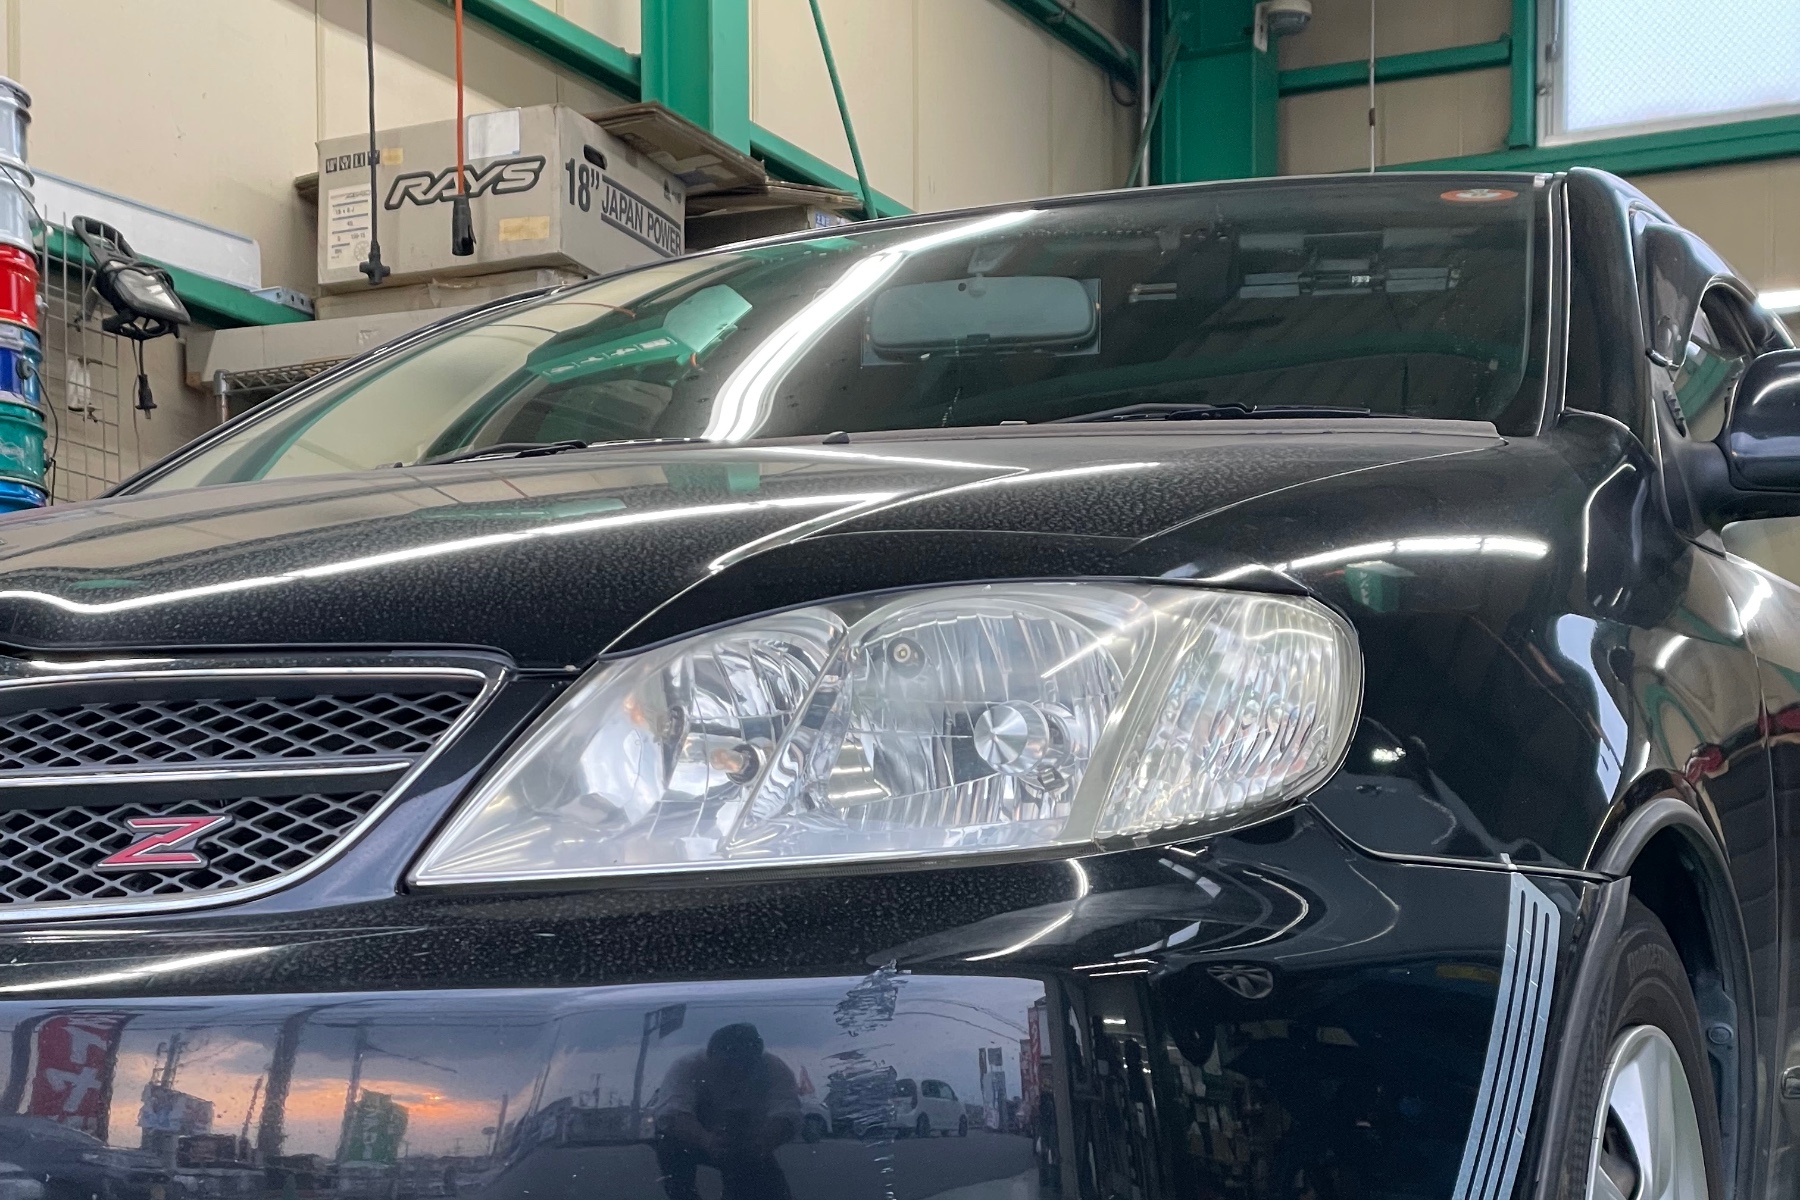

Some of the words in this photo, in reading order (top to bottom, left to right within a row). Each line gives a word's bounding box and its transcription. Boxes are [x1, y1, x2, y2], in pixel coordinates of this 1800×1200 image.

[385, 155, 546, 210] RAYS
[602, 185, 643, 233] JAPAN
[647, 210, 681, 256] POWER
[94, 814, 233, 872] Z
